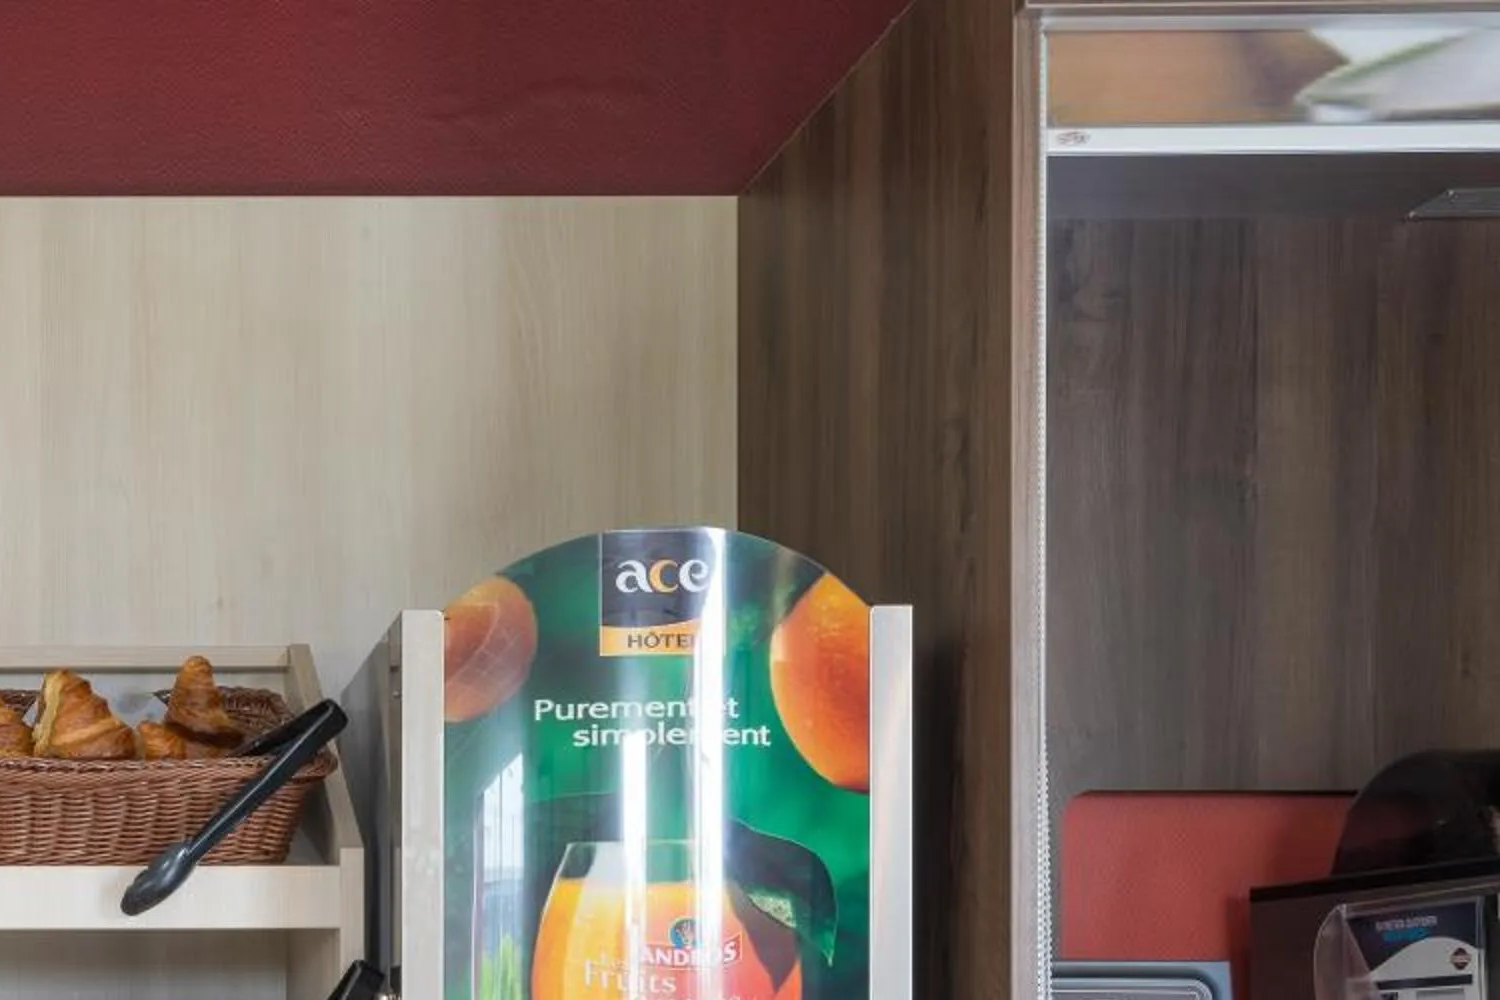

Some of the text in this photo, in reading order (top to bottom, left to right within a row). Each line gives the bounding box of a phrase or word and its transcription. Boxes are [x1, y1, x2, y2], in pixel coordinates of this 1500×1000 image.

[615, 559, 709, 593] ace
[627, 630, 696, 648] HÔTE
[572, 721, 772, 747] simpleent
[640, 938, 739, 967] ANDS
